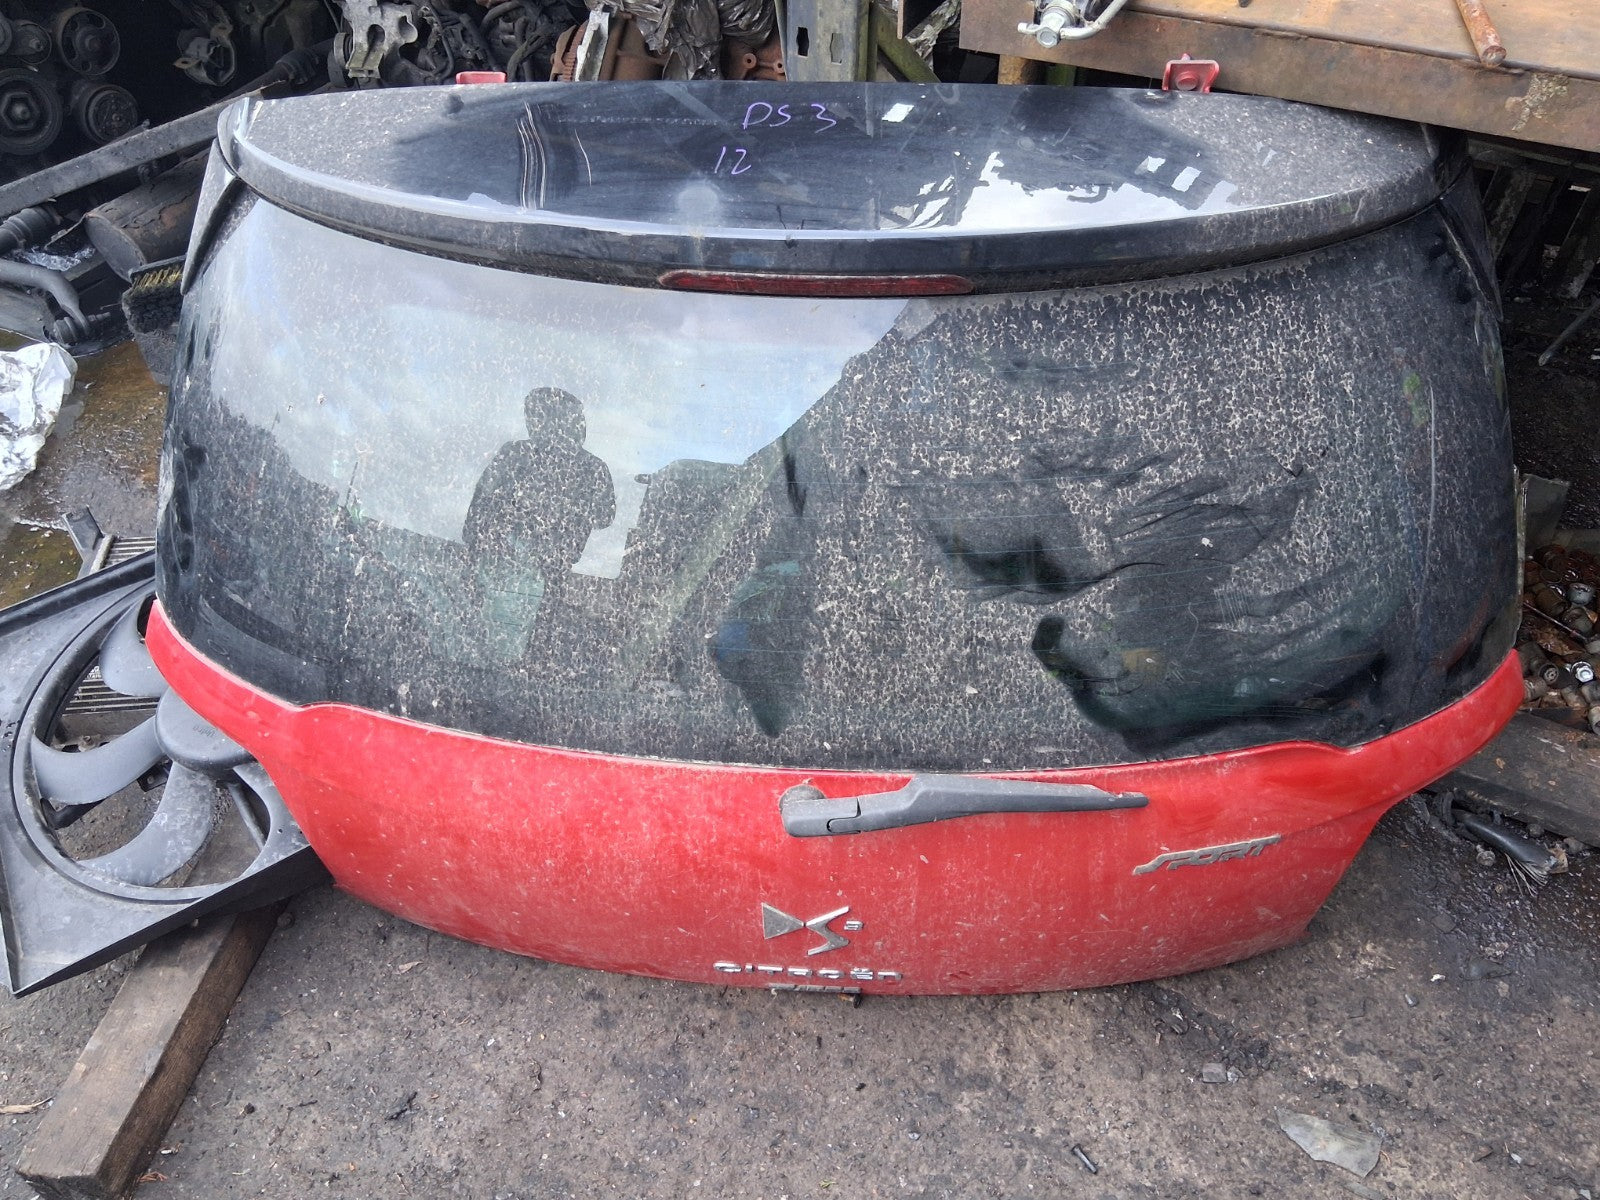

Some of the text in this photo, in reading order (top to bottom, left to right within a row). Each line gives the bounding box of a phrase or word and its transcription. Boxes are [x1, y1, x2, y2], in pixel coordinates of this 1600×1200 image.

[742, 101, 837, 134] DS 3
[713, 146, 752, 175] 12
